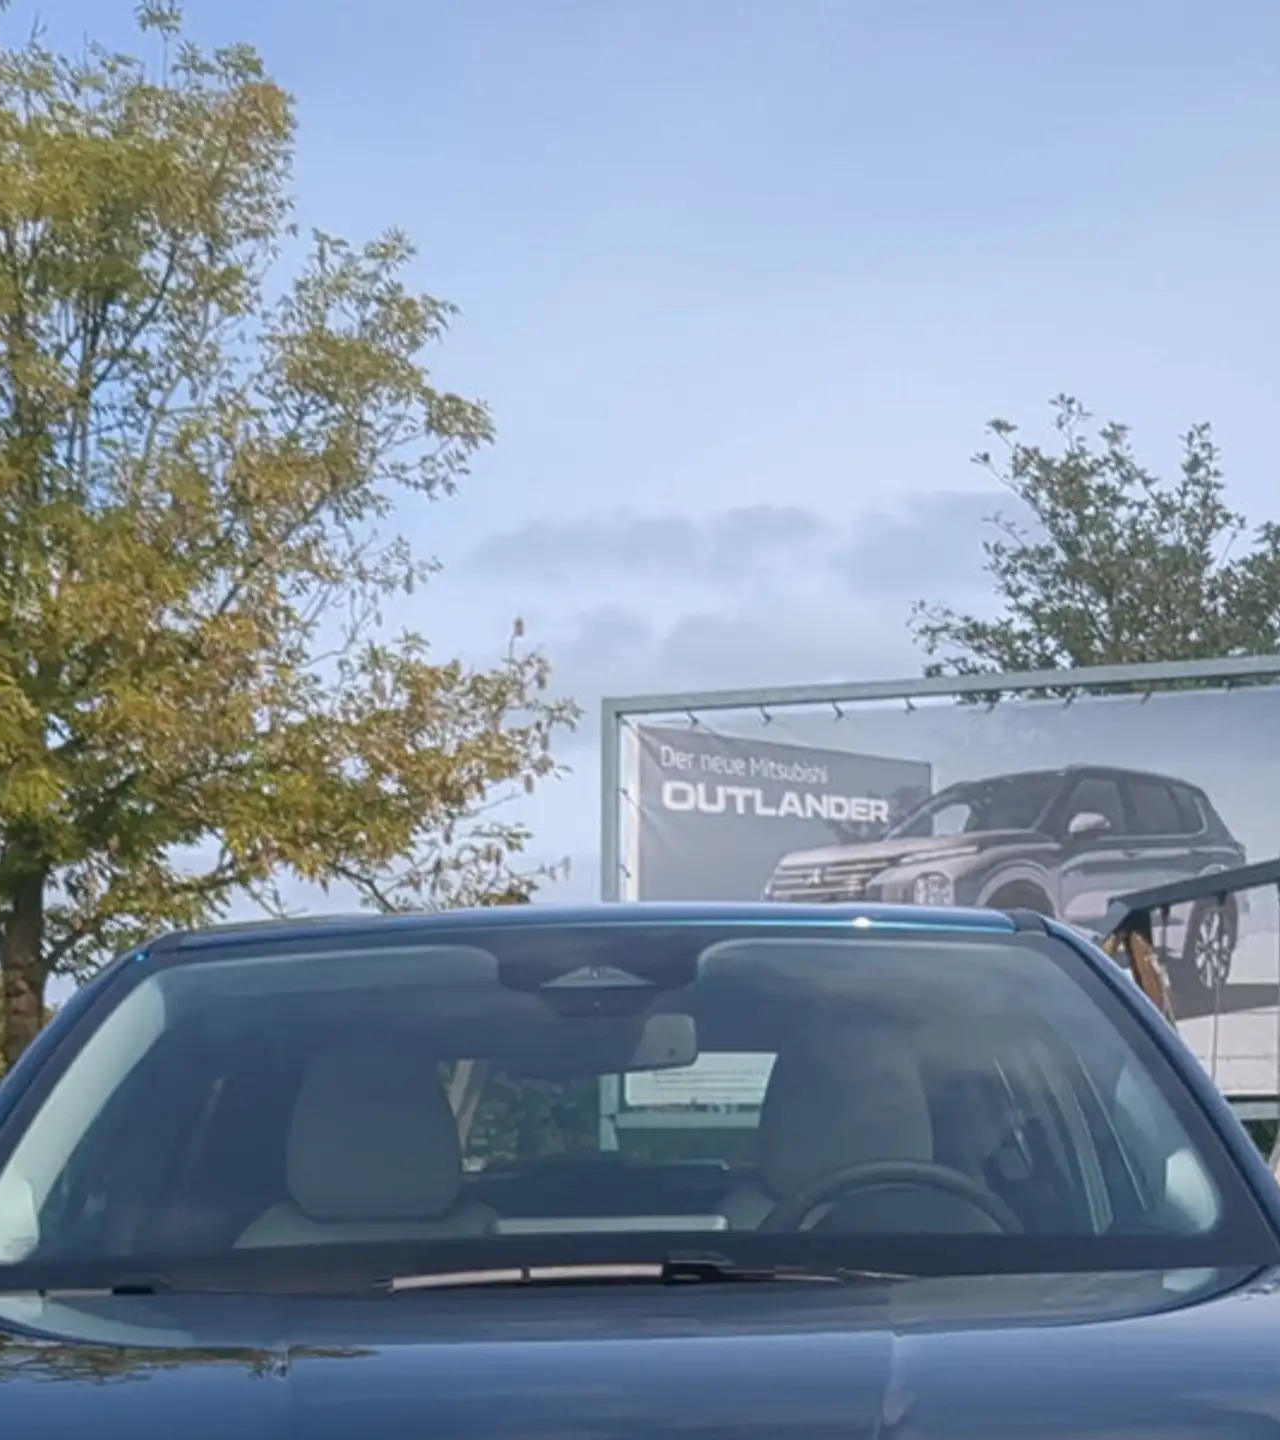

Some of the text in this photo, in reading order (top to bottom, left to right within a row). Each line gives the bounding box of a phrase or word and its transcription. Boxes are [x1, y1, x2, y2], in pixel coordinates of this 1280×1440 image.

[660, 745, 829, 784] Der neue Mitsubishi
[662, 781, 889, 823] OUTLANDER
